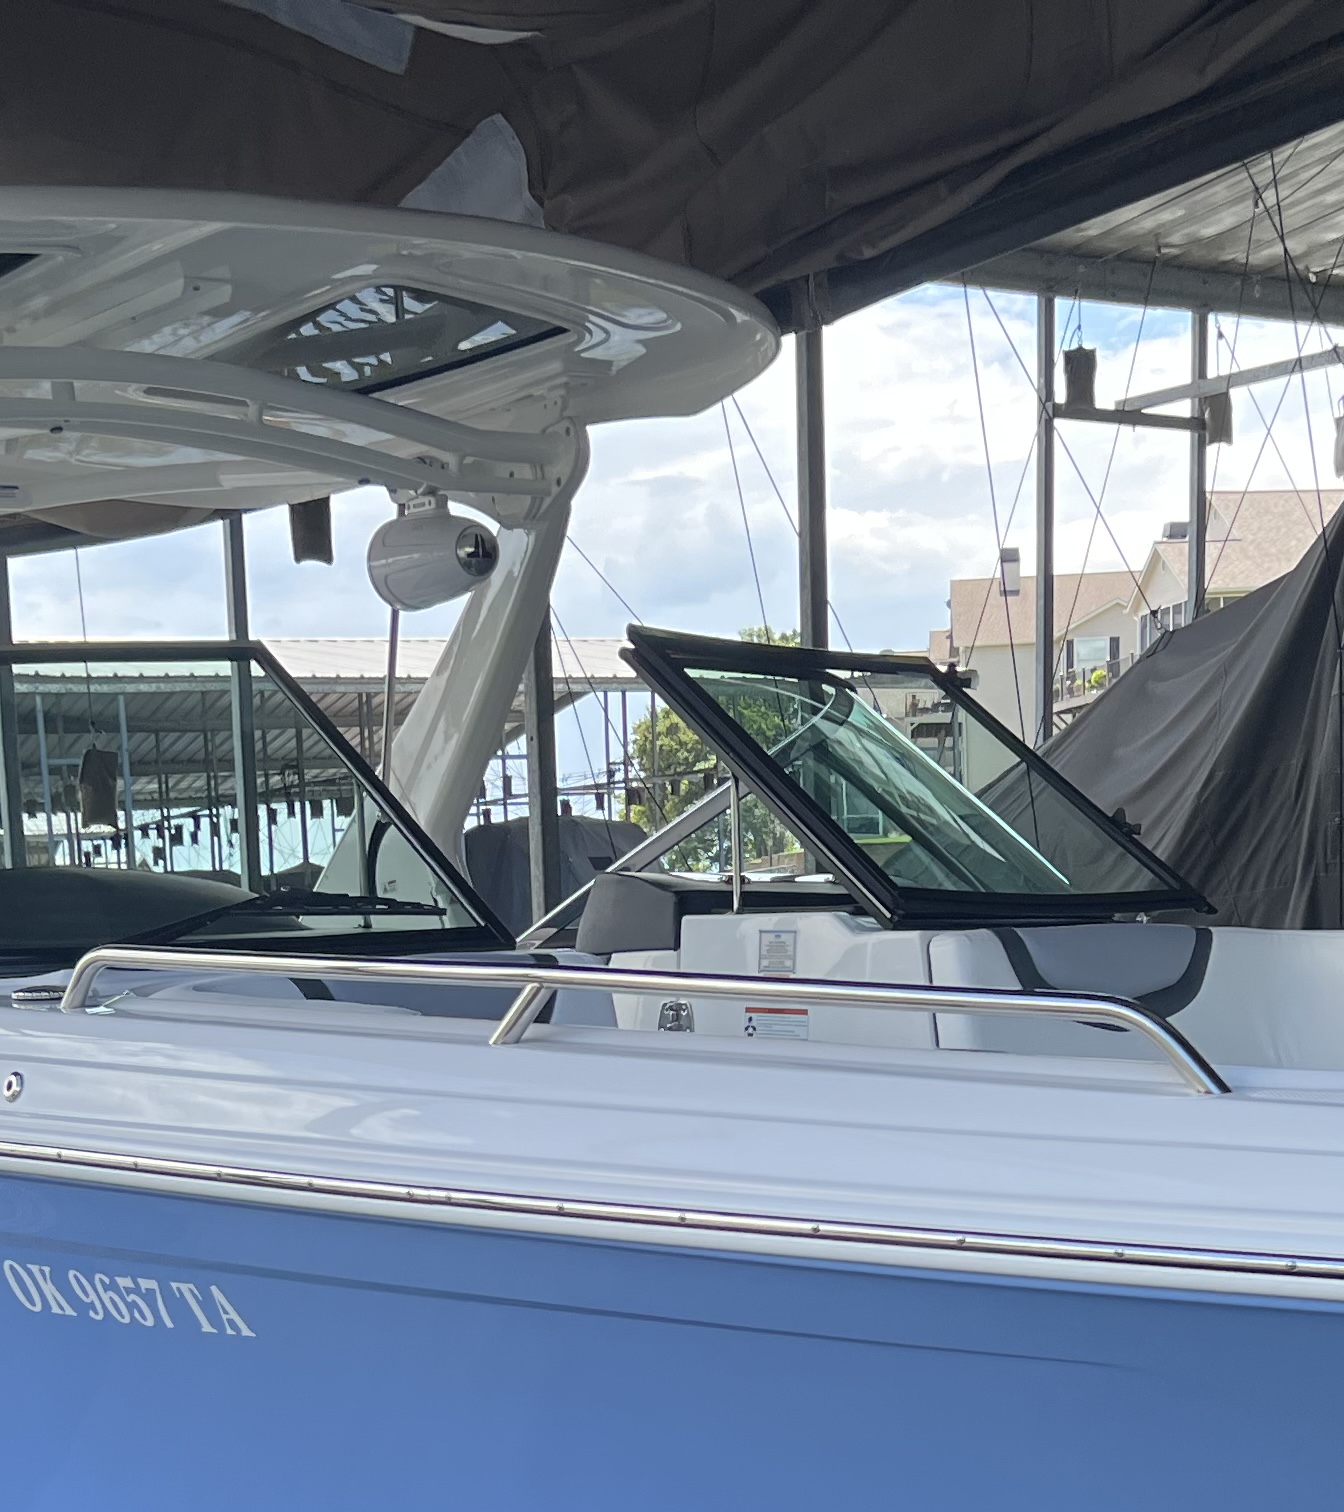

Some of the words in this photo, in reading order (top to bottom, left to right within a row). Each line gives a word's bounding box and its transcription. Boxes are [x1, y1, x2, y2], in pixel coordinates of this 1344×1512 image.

[2, 1258, 78, 1317] OK
[67, 1269, 175, 1330] 9657
[169, 1281, 257, 1338] TA
